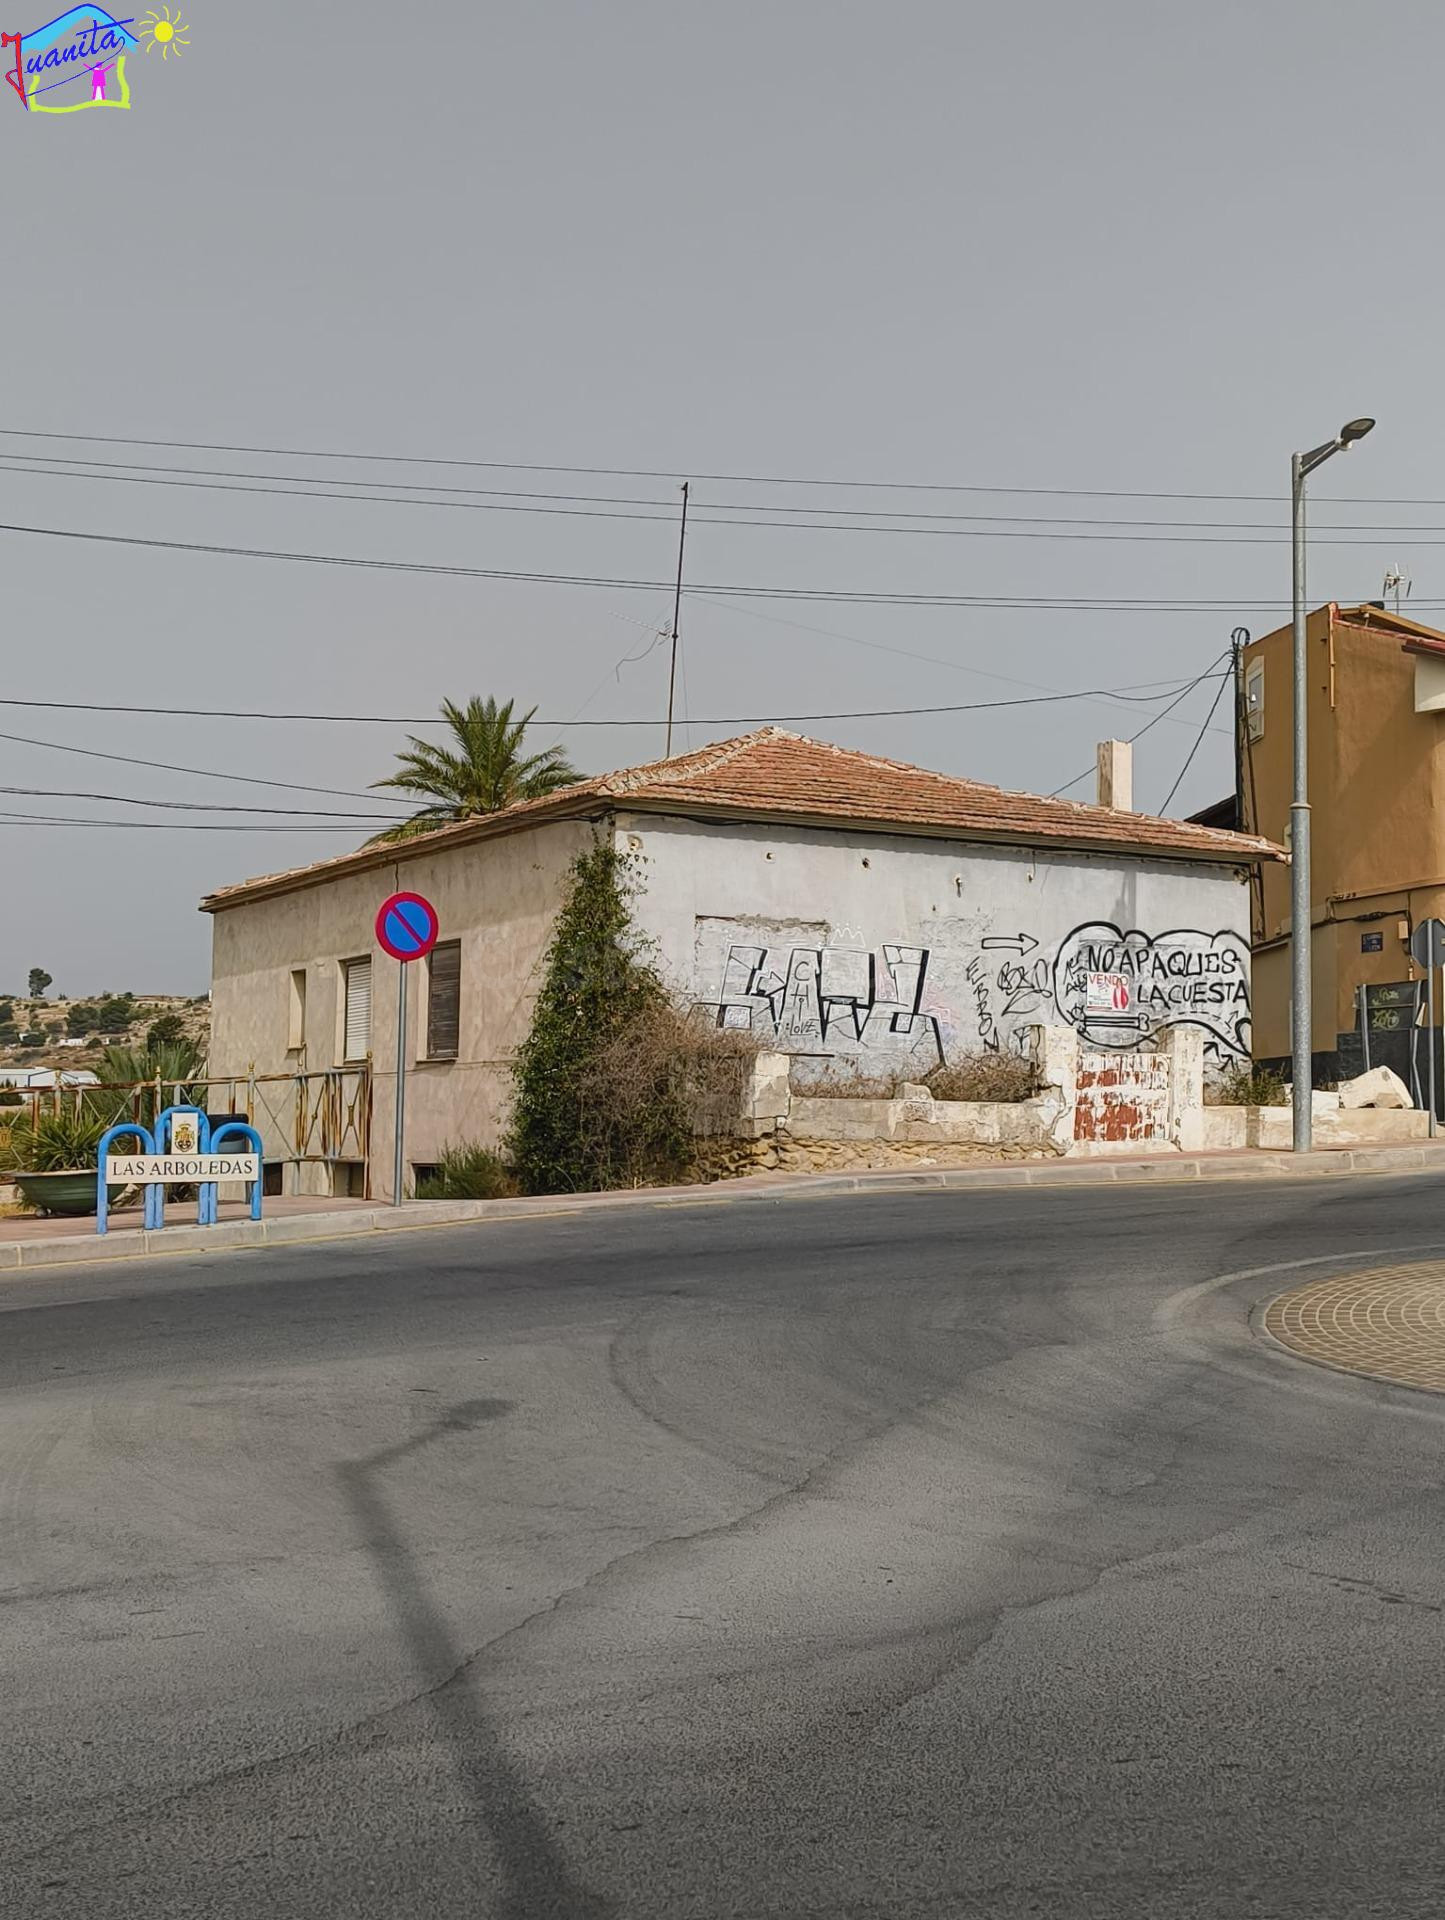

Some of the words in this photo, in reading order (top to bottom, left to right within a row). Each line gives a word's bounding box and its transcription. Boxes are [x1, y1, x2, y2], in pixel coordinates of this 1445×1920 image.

[1088, 945, 1115, 973] NO
[1119, 948, 1241, 980] APAQUES
[1088, 974, 1129, 986] VENDO
[1137, 983, 1171, 1010] LA
[1167, 979, 1252, 1012] CUESTA
[113, 1160, 145, 1176] LAS
[149, 1160, 253, 1176] ARBOLEDAS
